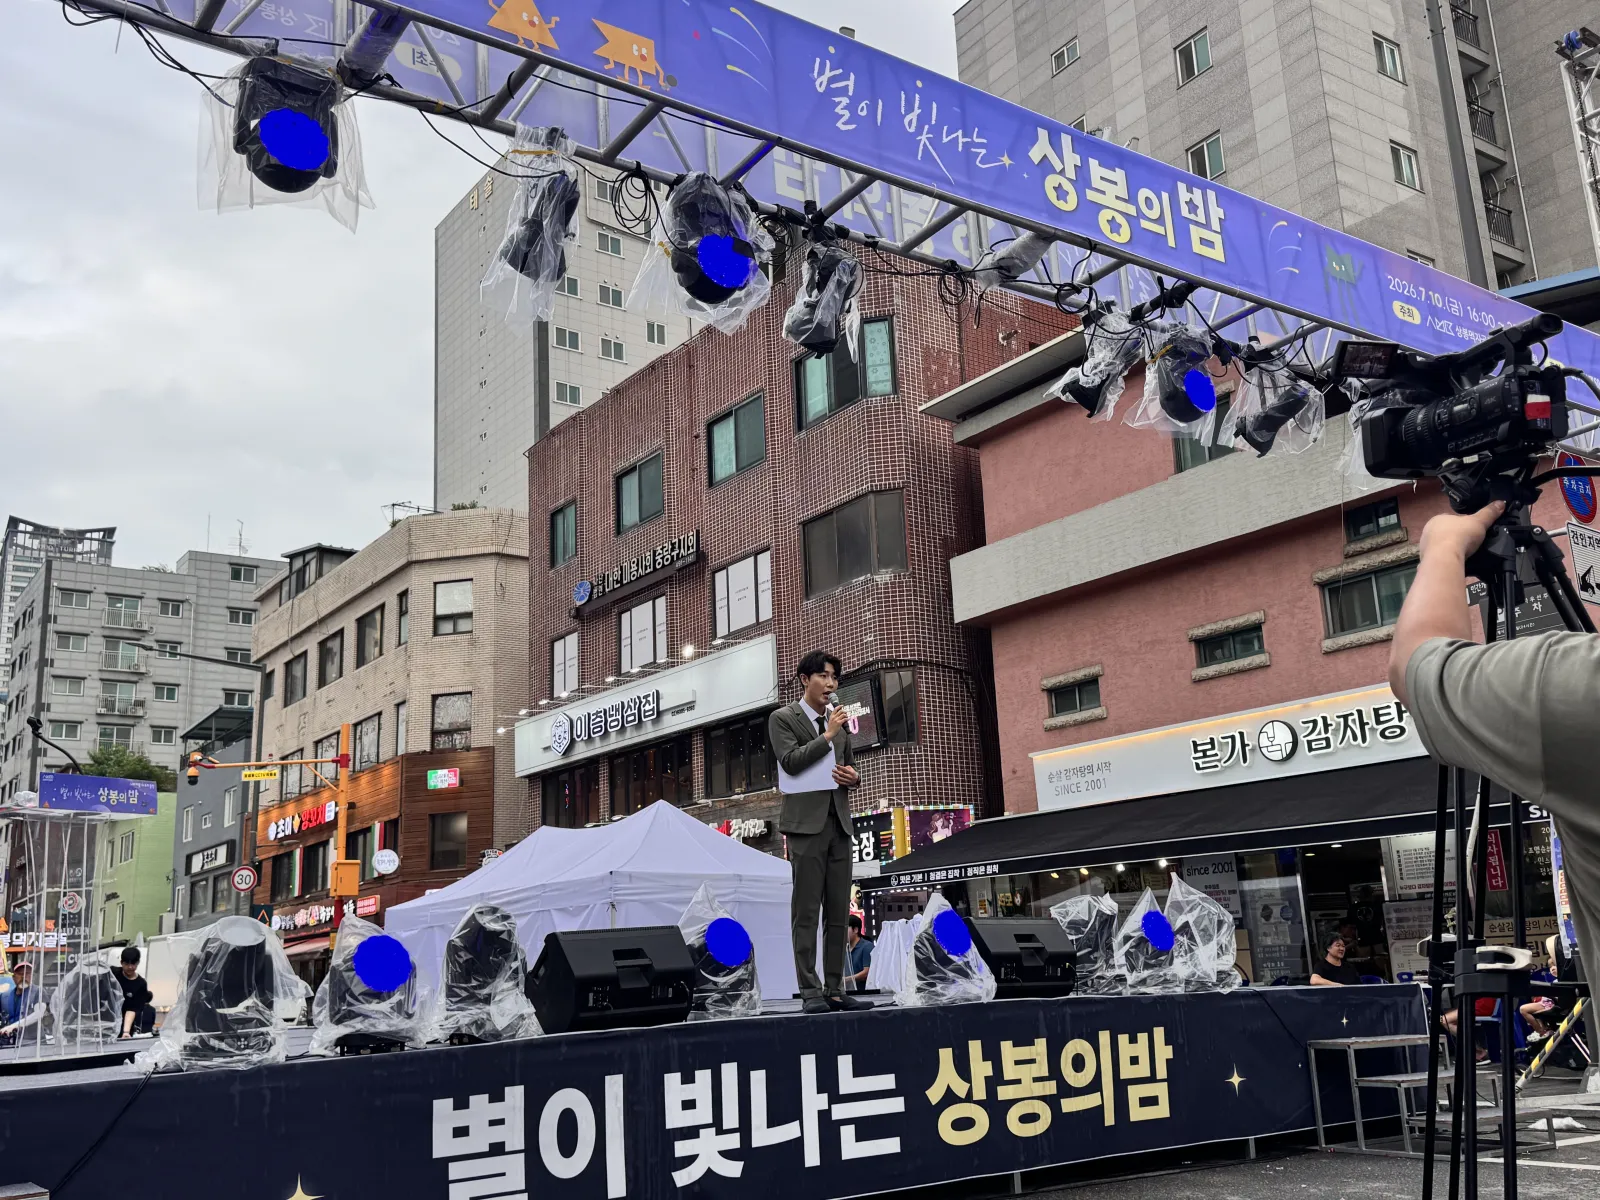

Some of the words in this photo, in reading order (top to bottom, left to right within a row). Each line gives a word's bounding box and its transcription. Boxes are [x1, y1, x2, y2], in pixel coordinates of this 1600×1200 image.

[900, 80, 1004, 185] 빛나는
[1028, 127, 1226, 263] 상봉의밤
[1387, 275, 1464, 318] 2026.7.10.(금)
[1467, 305, 1496, 329] 16:00
[655, 529, 697, 569] 중랑구지회
[574, 689, 659, 741] 이층냉삼집
[1191, 731, 1250, 772] 본가
[1301, 702, 1408, 754] 감자탕
[1054, 782, 1082, 797] SINCE
[1084, 778, 1107, 792] 2001
[1063, 764, 1095, 782] 감자탕의
[1096, 760, 1112, 776] 시작
[97, 787, 139, 806] 상봉의밤
[236, 874, 252, 885] 30
[1186, 864, 1209, 877] since
[1211, 861, 1235, 874] 2001
[432, 1073, 628, 1200] 별이
[663, 1053, 905, 1189] 빛나는
[924, 1026, 1174, 1147] 상봉의밤
